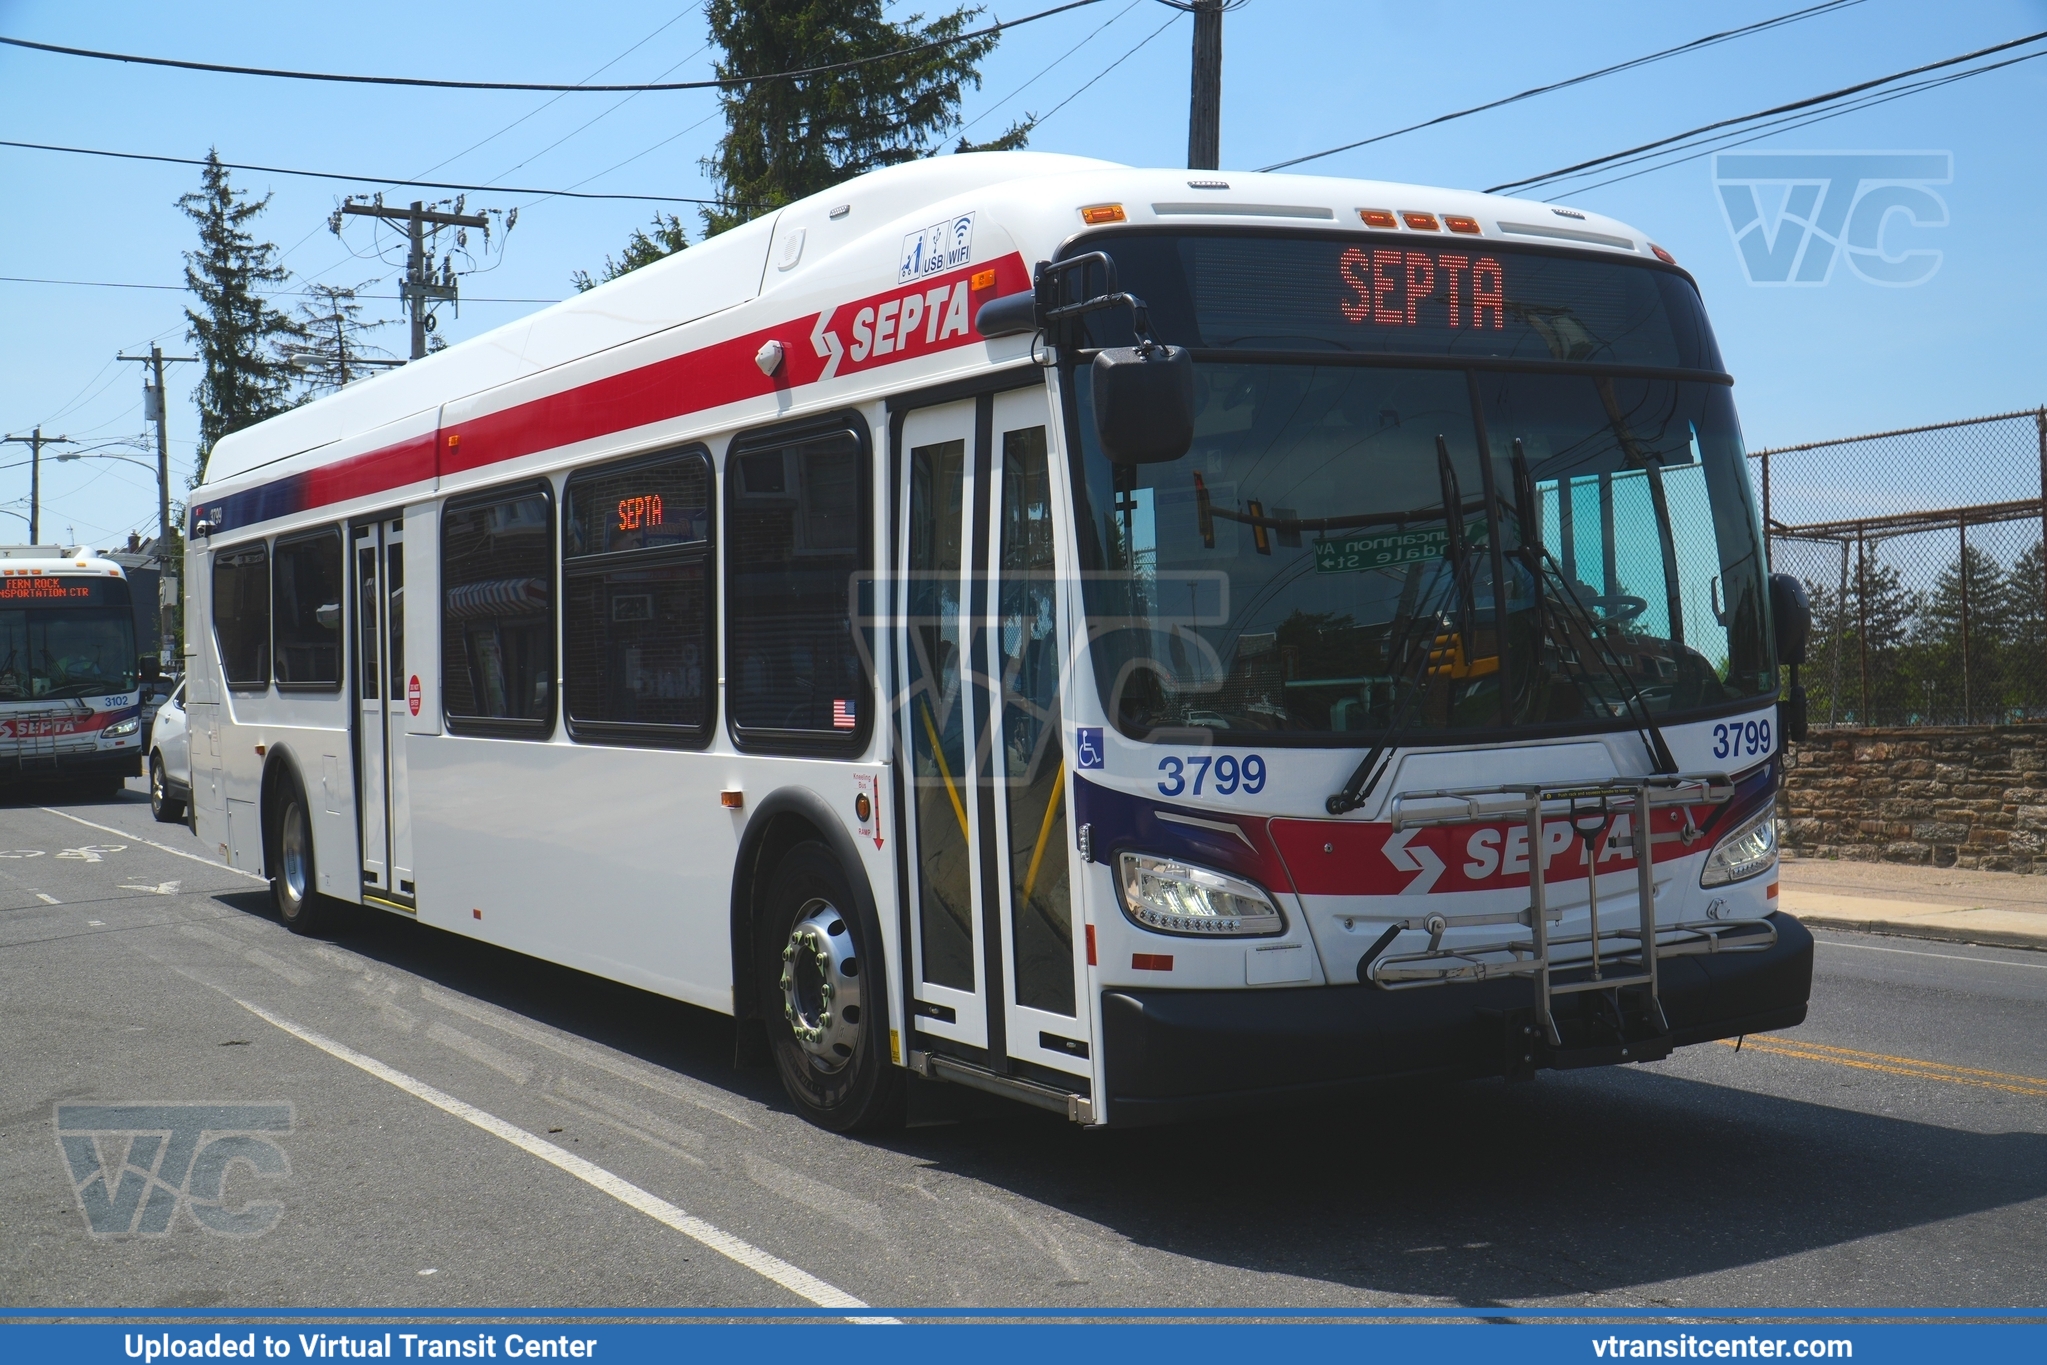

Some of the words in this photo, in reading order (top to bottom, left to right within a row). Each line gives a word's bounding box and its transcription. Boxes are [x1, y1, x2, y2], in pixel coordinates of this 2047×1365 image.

[923, 254, 944, 274] USB
[948, 245, 970, 266] WIFI
[1340, 248, 1503, 328] SEPTA
[850, 280, 969, 362] SEPTA
[618, 494, 662, 531] SEPTA
[6, 578, 31, 589] FERN
[34, 578, 60, 588] ROCK
[69, 588, 89, 597] CTR
[105, 695, 129, 707] 3102
[16, 721, 75, 735] SEPTA
[1712, 719, 1771, 759] 3799
[853, 773, 871, 782] Kneeling
[1157, 754, 1267, 797] 3799
[858, 828, 871, 836] RAMP
[1463, 814, 1636, 880] SEPTA
